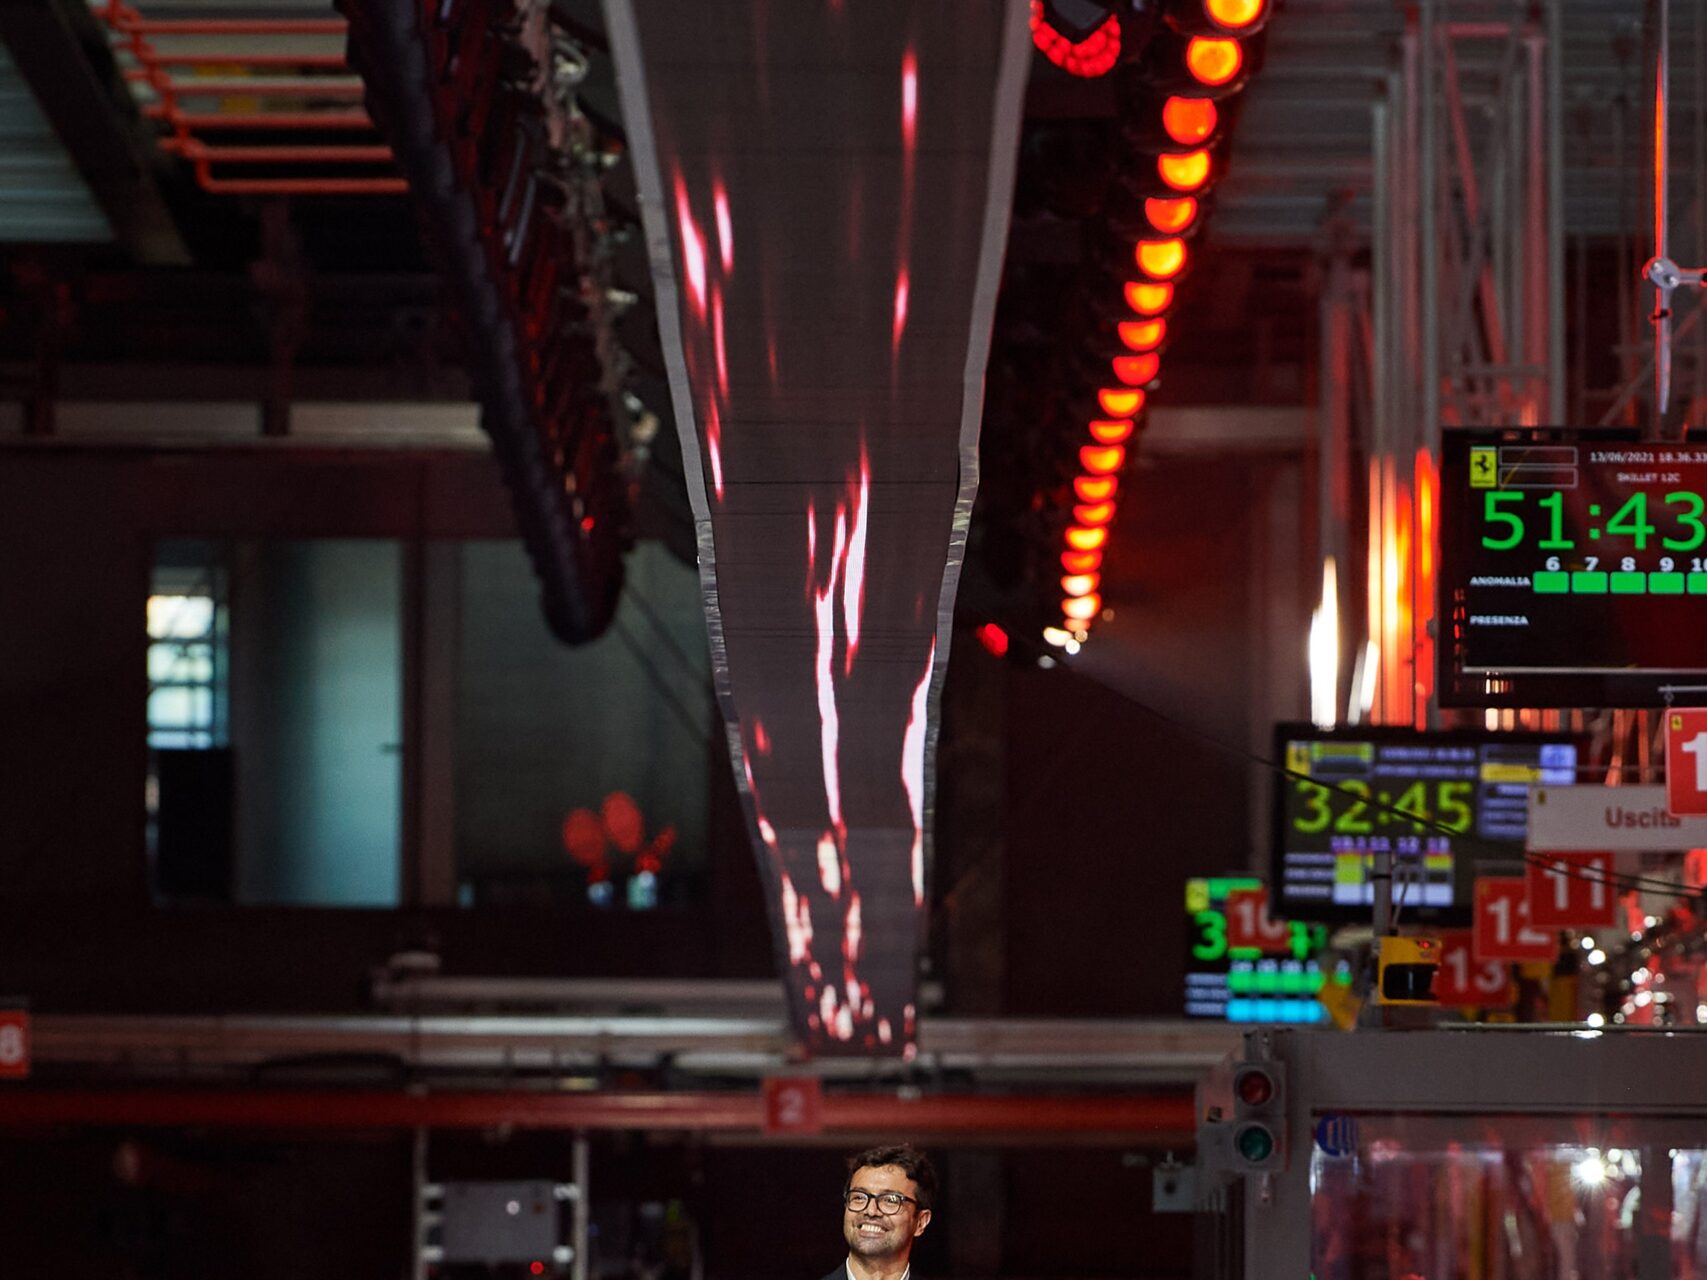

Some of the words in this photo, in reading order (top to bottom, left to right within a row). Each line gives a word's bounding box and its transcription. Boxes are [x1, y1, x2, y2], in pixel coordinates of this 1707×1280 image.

[1482, 491, 1707, 550] 51:43
[1470, 576, 1531, 586] ANOMALIA
[1546, 557, 1560, 571] 6
[1585, 557, 1599, 571] 7
[1621, 557, 1636, 571] 8
[1660, 557, 1674, 572] 9
[1470, 615, 1529, 625] PRESENZA
[1294, 779, 1472, 833] 32:45
[1543, 858, 1605, 910] 11
